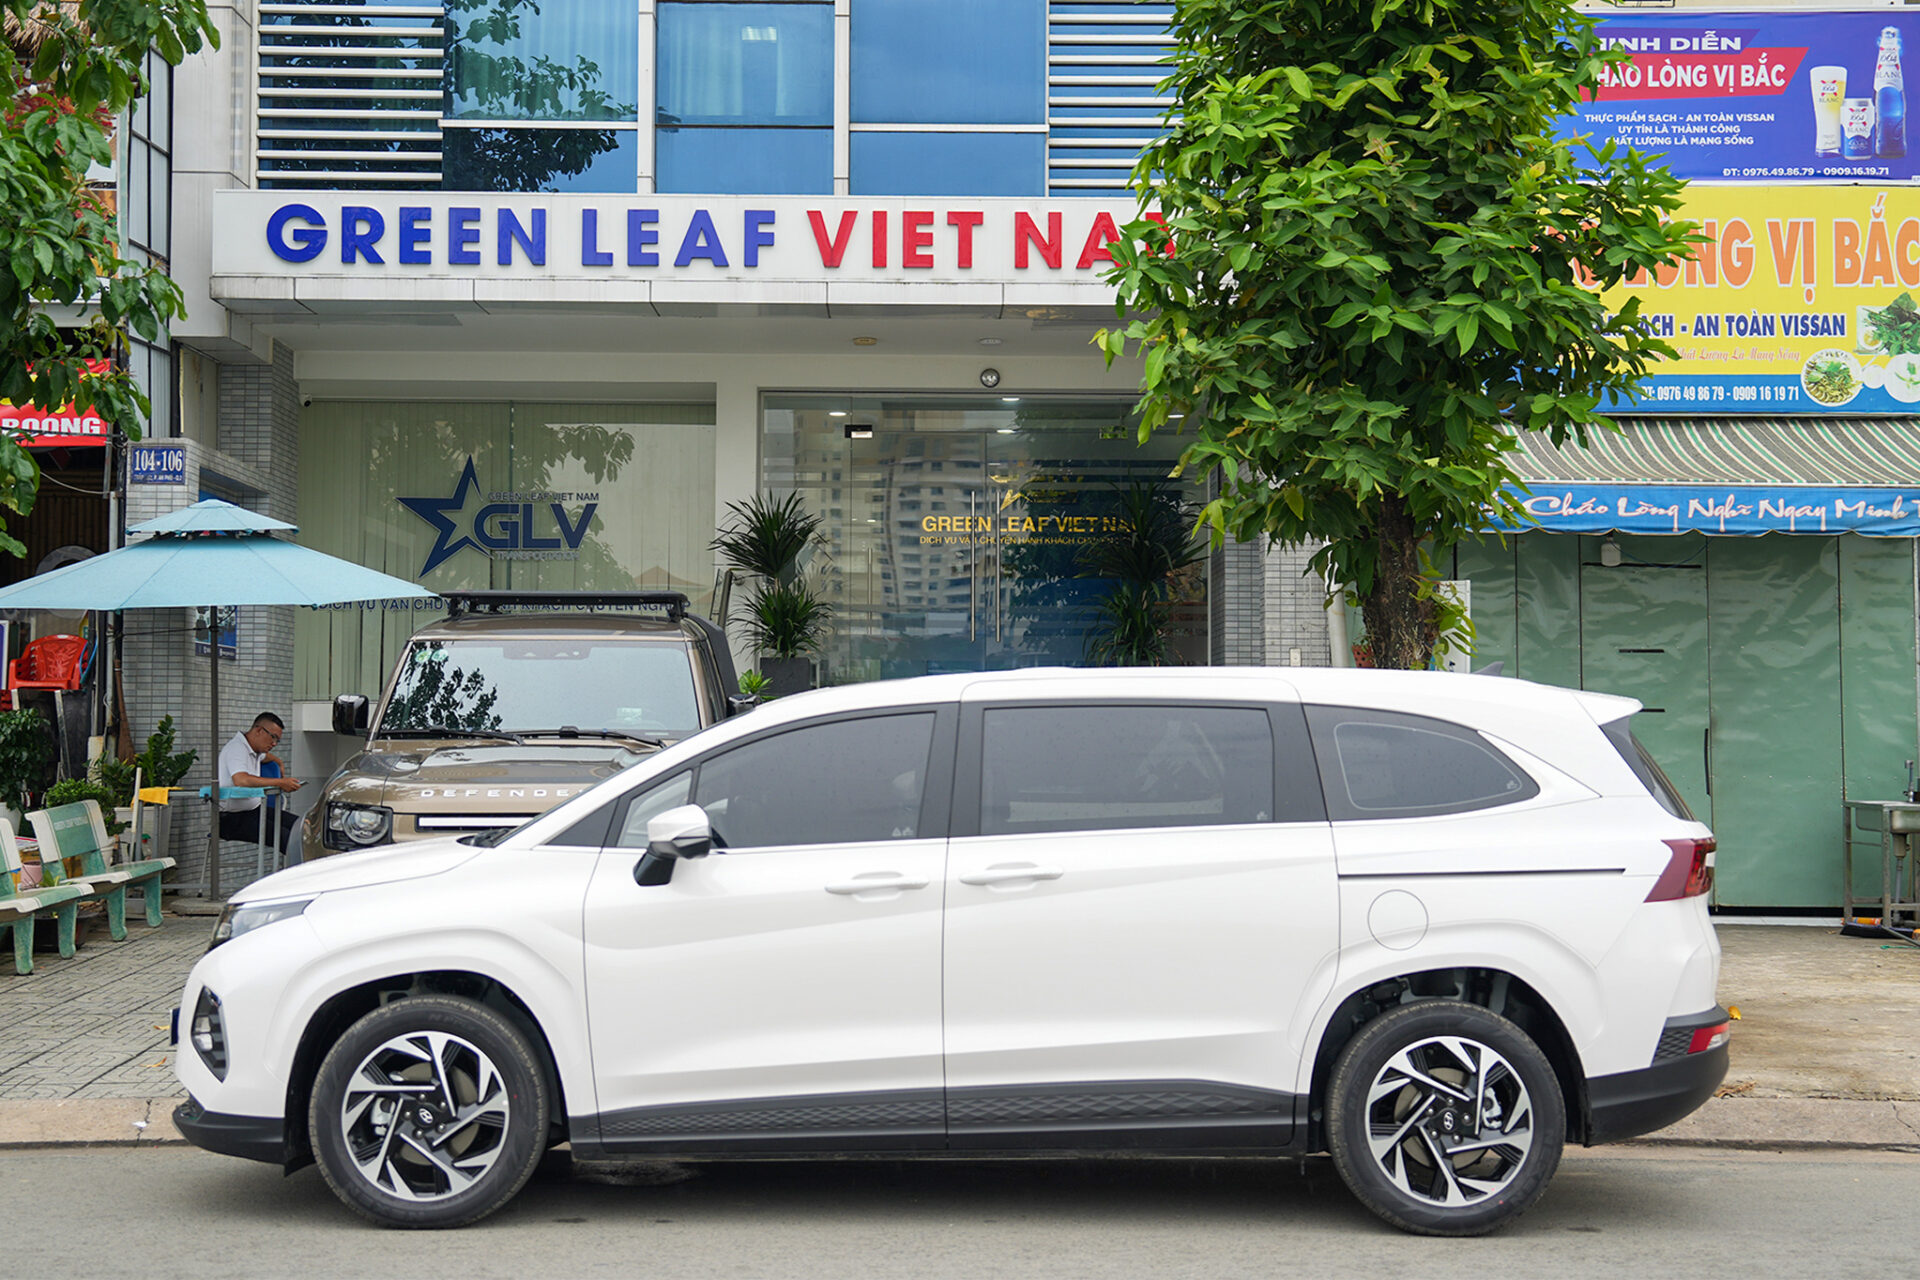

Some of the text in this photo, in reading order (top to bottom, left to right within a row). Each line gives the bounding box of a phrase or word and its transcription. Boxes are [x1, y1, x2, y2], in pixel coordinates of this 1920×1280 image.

[1670, 30, 1741, 51] DIỄN
[1647, 58, 1708, 88] LÒNG
[1713, 64, 1735, 93] VỊ
[1740, 52, 1786, 88] BẮC
[1584, 114, 1613, 125] THỰC
[1616, 110, 1646, 123] PHẨM
[1648, 114, 1677, 125] SẠCH
[1686, 114, 1702, 123] AN
[1704, 112, 1734, 123] TOÀN
[1736, 113, 1775, 123] VISSAN
[1618, 123, 1741, 134] UY TÍN LÀ THÀNH CÔNG
[1635, 136, 1672, 147] LƯỢNG
[1674, 134, 1688, 145] LÀ
[1691, 136, 1722, 147] MẠNG
[1724, 134, 1755, 145] SỐNG
[1723, 168, 1741, 177] ĐT:
[1743, 168, 1815, 177] 0976.49.86.79
[1823, 167, 1889, 176] 0909.16.19.71
[266, 203, 547, 266] GREEN
[582, 208, 776, 267] LEAF
[806, 210, 984, 269] VIET
[1766, 218, 1816, 305] VỊ
[1833, 192, 1920, 289] BẮC
[1692, 313, 1720, 338] AN
[1725, 309, 1775, 338] TOÀN
[1780, 313, 1846, 338] VISSAN
[1657, 386, 1681, 400] 0976
[1683, 386, 1696, 400] 49
[1697, 386, 1710, 400] 86
[1712, 386, 1725, 400] 79
[1733, 386, 1757, 400] 0909
[1759, 386, 1771, 400] 16
[1773, 386, 1786, 400] 19
[1787, 386, 1799, 400] 71
[488, 492, 600, 501] GREEN LEAF VIET NAM
[1522, 491, 1609, 516] Cháo
[1617, 496, 1679, 532] Lòng
[1758, 497, 1826, 532] Ngay
[1835, 494, 1909, 519] Minh
[473, 503, 598, 549] GLV
[922, 515, 992, 532] GREEN
[1056, 516, 1098, 532] VIET
[1103, 516, 1136, 532] NA
[420, 789, 582, 798] DEFENDE
